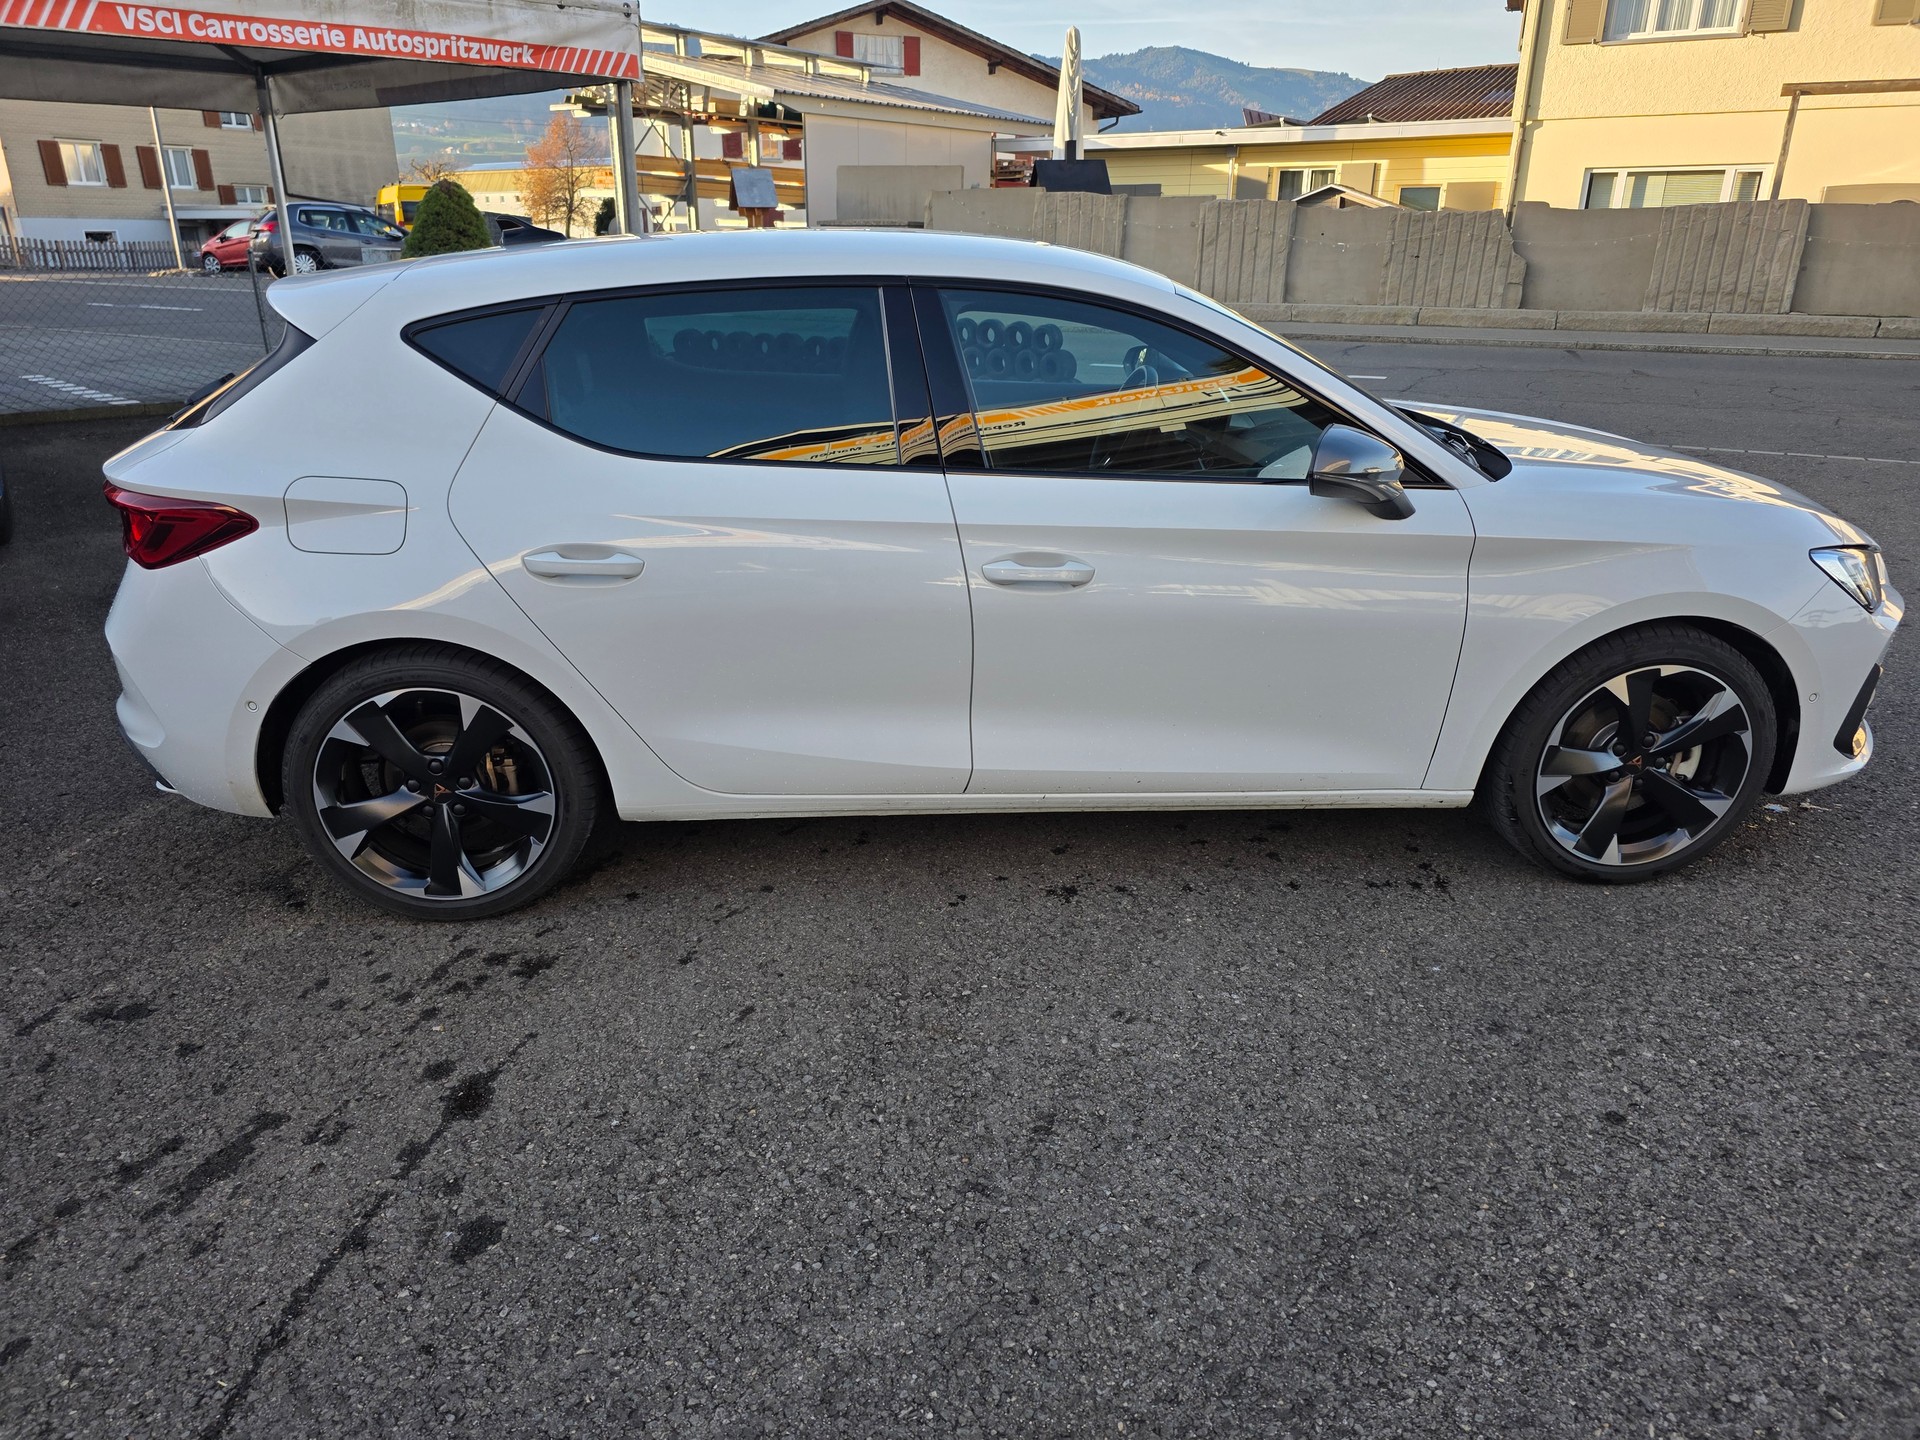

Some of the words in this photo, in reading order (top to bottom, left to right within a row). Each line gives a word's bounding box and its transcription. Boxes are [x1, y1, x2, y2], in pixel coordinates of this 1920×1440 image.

[116, 6, 183, 35] VSCI
[188, 14, 346, 48] Carrosserie
[352, 28, 536, 65] Autospritzwerk
